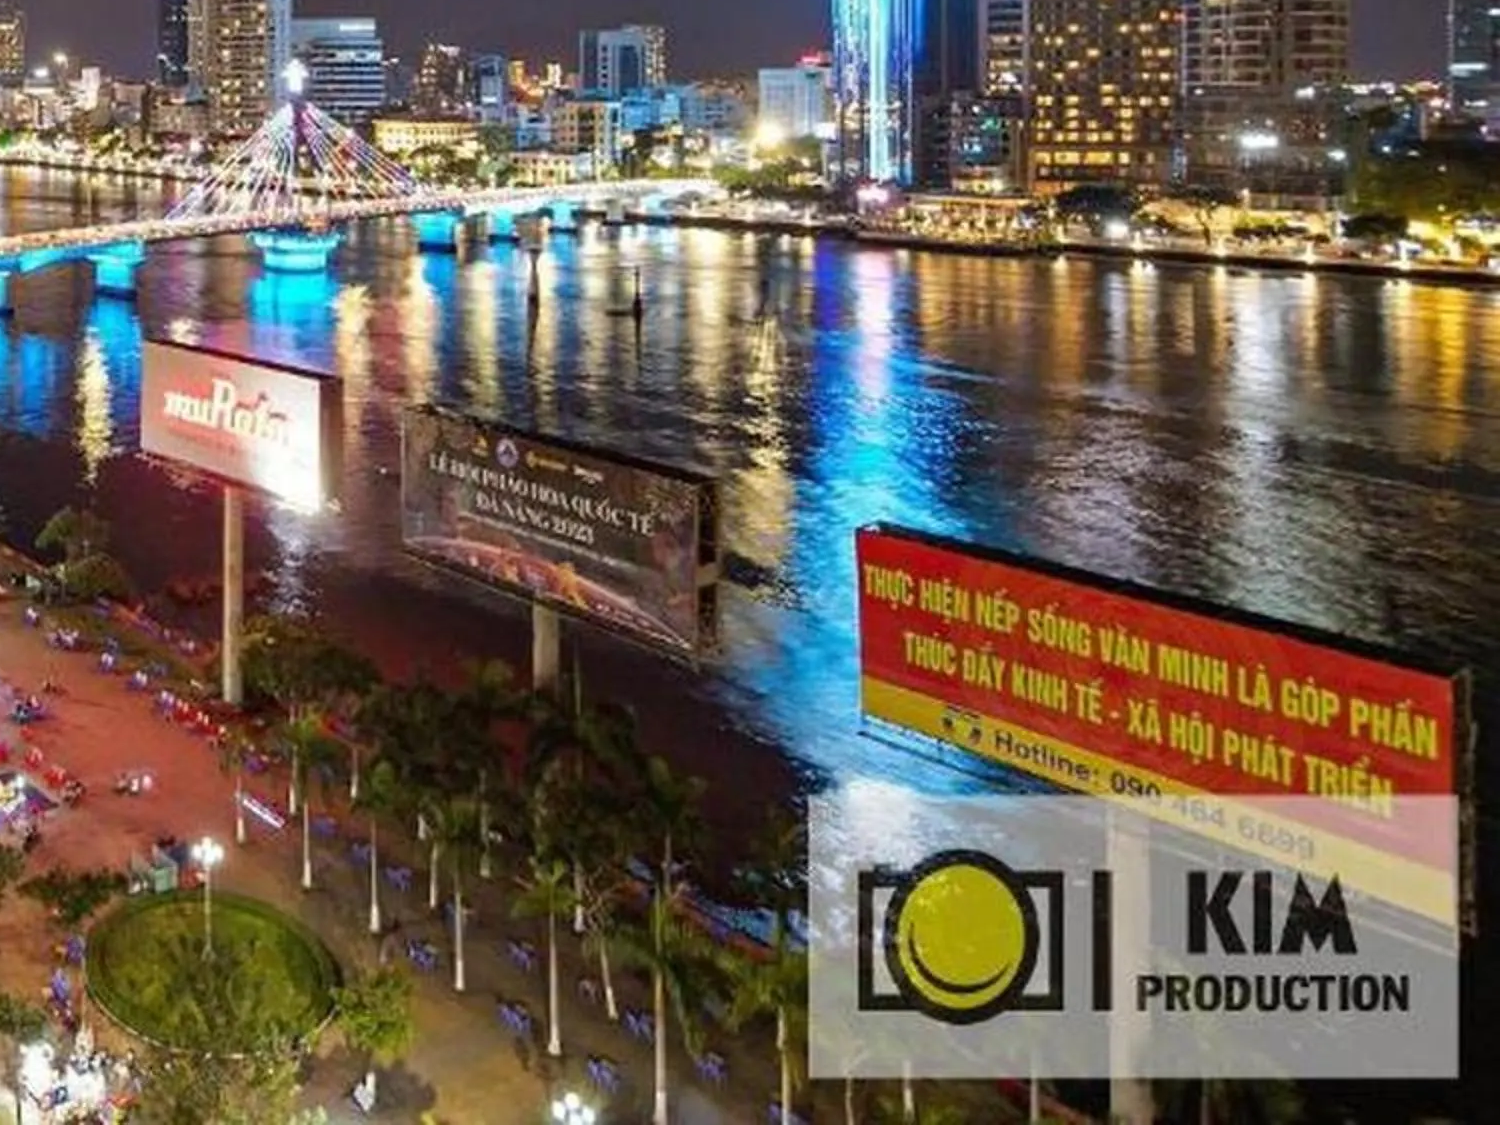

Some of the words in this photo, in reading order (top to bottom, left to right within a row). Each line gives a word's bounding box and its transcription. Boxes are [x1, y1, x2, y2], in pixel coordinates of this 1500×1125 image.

[863, 563, 914, 610] THỰC
[919, 577, 970, 625] HIỆN
[975, 587, 1021, 634] NẾP
[1027, 601, 1092, 658] SỐNG
[1158, 643, 1229, 698] MINH
[1280, 675, 1340, 728] GÓP
[903, 631, 957, 675] THÚC
[1011, 661, 1068, 713] KINH
[1074, 677, 1104, 724] TẾ
[1169, 710, 1214, 765] HỘI
[1223, 728, 1295, 787] PHÁT
[994, 730, 1100, 786] Hotline:
